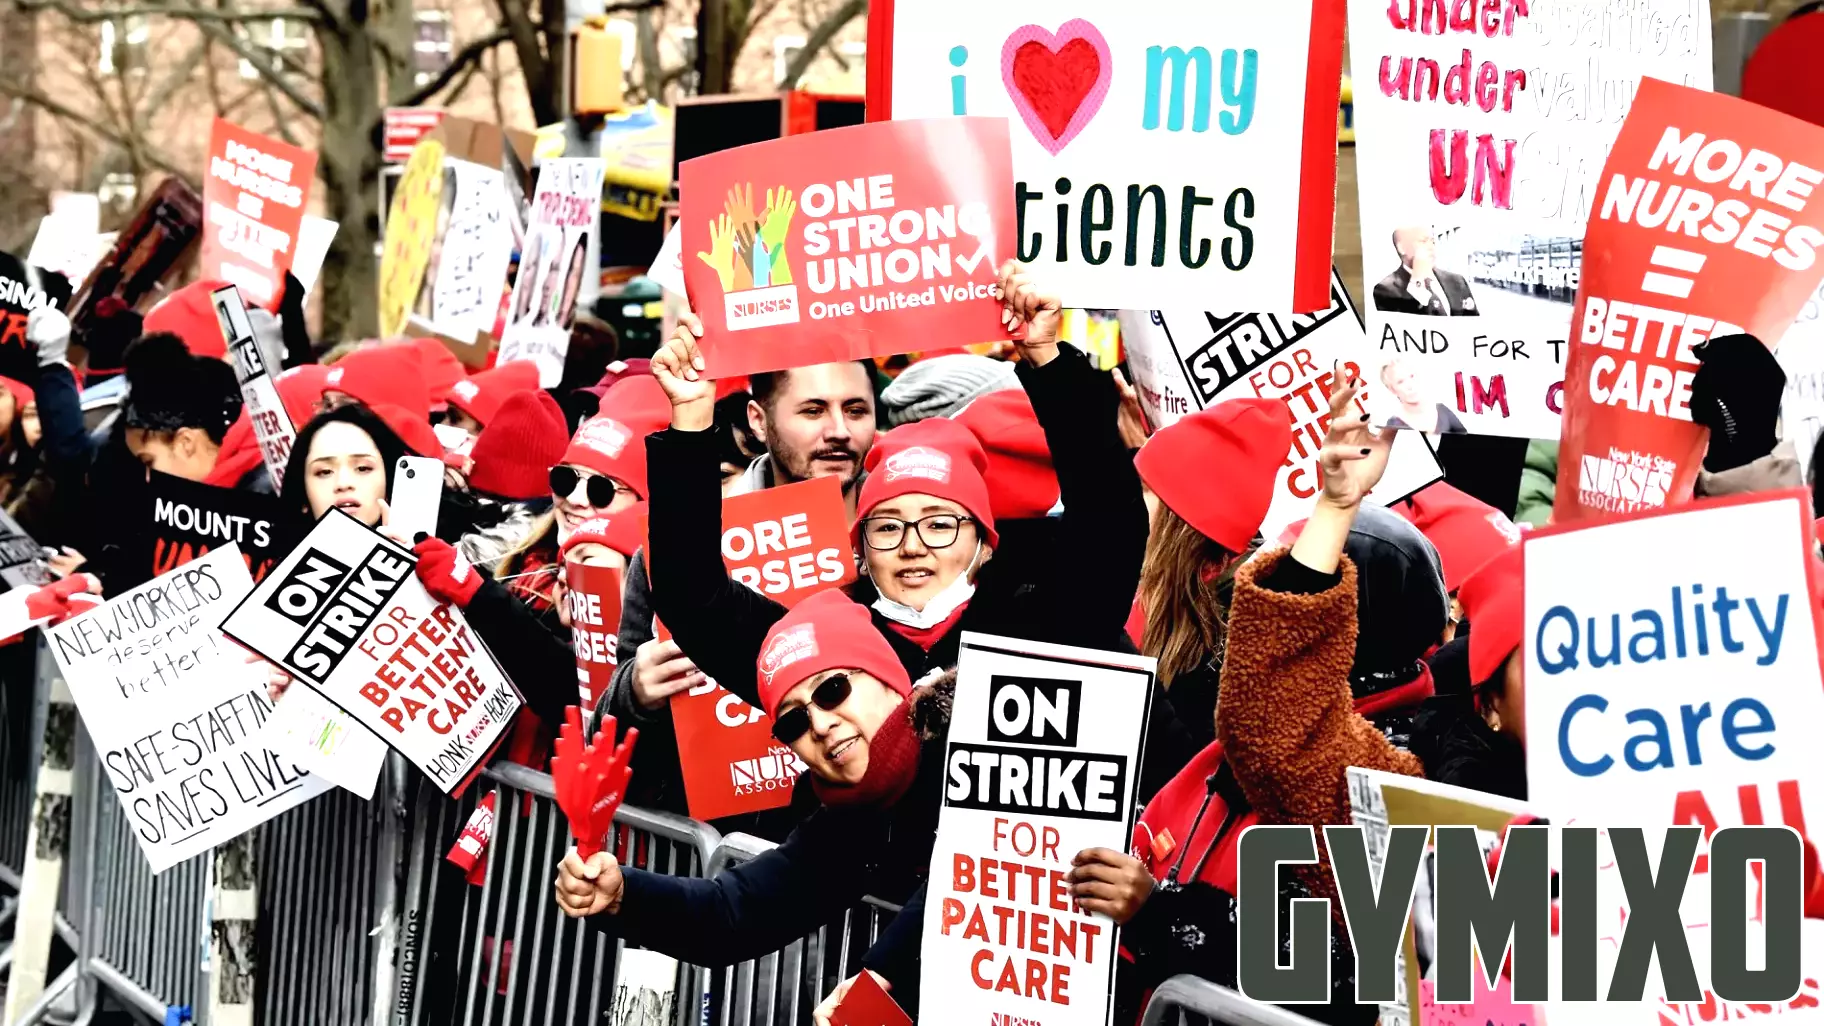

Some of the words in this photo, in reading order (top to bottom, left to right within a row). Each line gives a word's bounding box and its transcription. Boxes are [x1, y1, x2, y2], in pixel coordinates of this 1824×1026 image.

[948, 44, 969, 116] i
[1142, 44, 1259, 135] my
[1647, 126, 1824, 213] MORE
[800, 174, 895, 218] ONE
[803, 202, 992, 256] STRONG
[1015, 177, 1256, 271] tients
[1600, 173, 1824, 271] NURSES
[806, 244, 952, 294] UNION
[732, 297, 793, 319] NURSES
[809, 298, 856, 320] One
[860, 286, 936, 315] United
[942, 281, 999, 304] Voice
[1380, 323, 1449, 354] AND
[1473, 335, 1530, 360] FOR
[1249, 349, 1319, 399] FOR
[1454, 371, 1511, 419] IM
[1164, 385, 1188, 415] fire
[1579, 454, 1674, 507] NURSES
[154, 498, 250, 543] MOUNT
[721, 513, 812, 562] ORE
[278, 556, 344, 617] ON
[730, 547, 845, 596] RSES
[292, 549, 411, 678] STRIKE
[569, 588, 604, 626] ORE
[1536, 583, 1790, 675] Quality
[358, 605, 417, 662] FOR
[358, 604, 458, 708] BETTER
[574, 629, 618, 665] RSES
[380, 624, 476, 734] PATIENT
[427, 666, 486, 735] CARE
[484, 683, 514, 724] HONK
[992, 684, 1071, 740] ON
[1558, 693, 1776, 778] Care
[426, 735, 475, 785] HONK
[730, 753, 810, 787] NUR
[768, 745, 792, 756] New
[134, 768, 228, 843] SAVES
[735, 777, 795, 796] ASSOCI
[948, 749, 1120, 814] STRIKE
[993, 817, 1060, 863] FOR
[941, 897, 1101, 964] PATIENT
[970, 949, 1070, 1005] CARE
